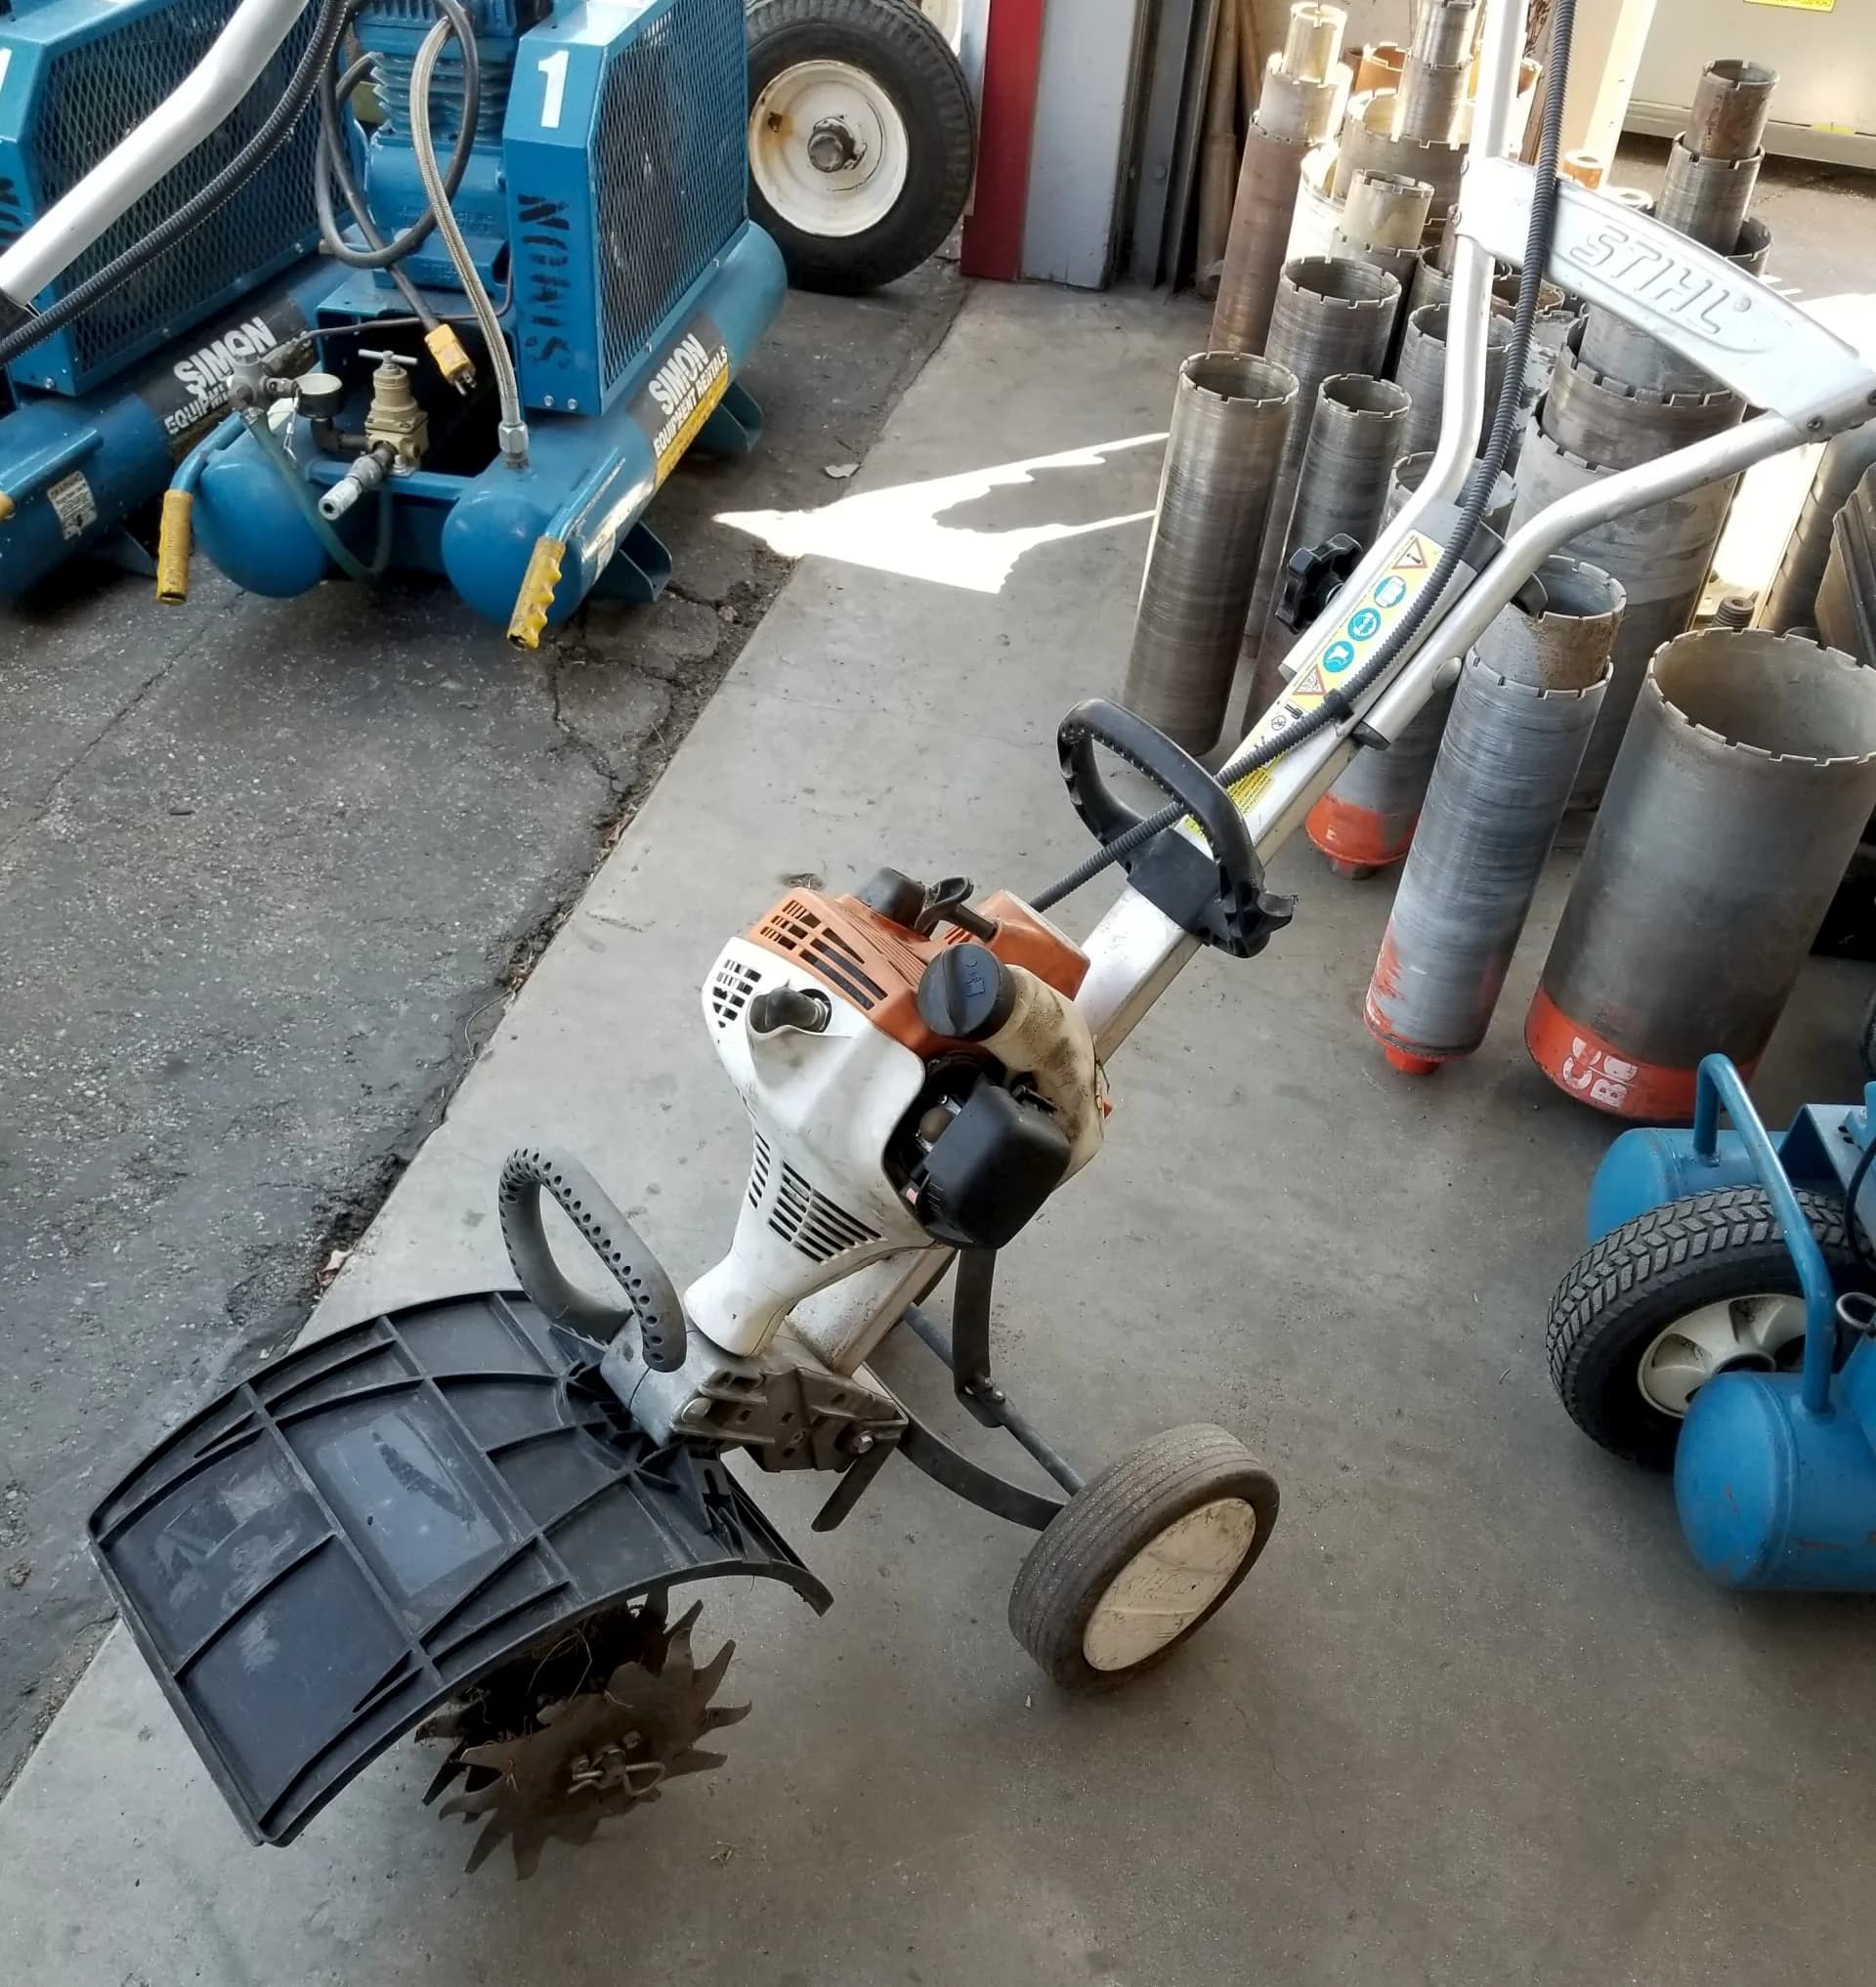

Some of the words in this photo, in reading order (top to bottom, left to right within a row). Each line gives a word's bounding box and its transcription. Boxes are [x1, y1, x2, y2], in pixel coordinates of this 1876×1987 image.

[537, 50, 570, 128] 1
[1570, 225, 1729, 334] STIHL
[173, 316, 277, 395] SIMON
[648, 333, 709, 416] SIMON
[653, 387, 698, 459] EQUIPMENT
[695, 345, 728, 399] RENTALS
